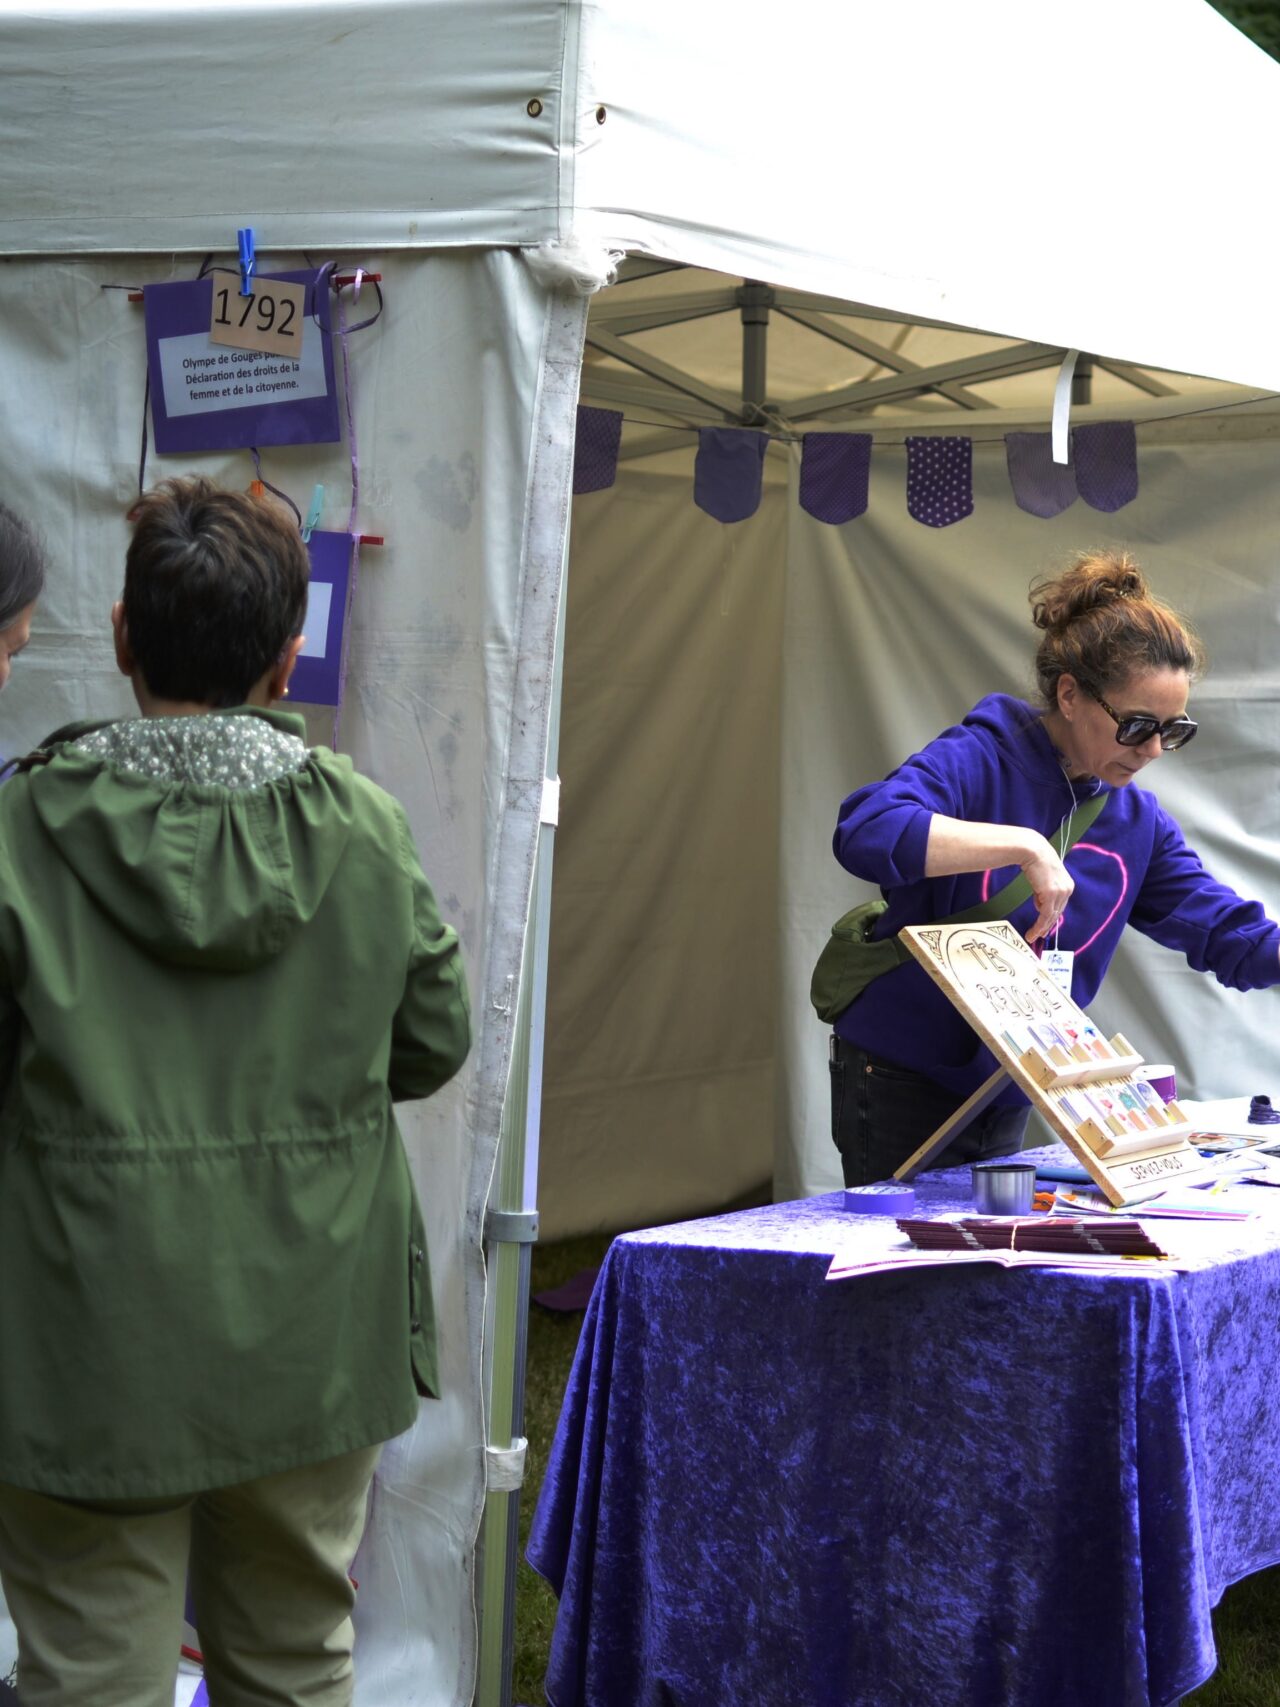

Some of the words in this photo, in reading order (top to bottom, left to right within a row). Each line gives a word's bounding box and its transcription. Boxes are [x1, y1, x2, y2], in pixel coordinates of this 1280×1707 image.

[214, 288, 296, 337] 1792
[182, 358, 216, 370] Olympe
[218, 354, 229, 364] de
[230, 351, 262, 363] Gouges
[185, 370, 235, 384] Déclaration
[236, 369, 252, 379] des
[253, 364, 278, 377] droits
[279, 363, 290, 373] de
[292, 362, 300, 372] la
[189, 389, 220, 400] femme
[222, 387, 230, 397] et
[232, 384, 244, 394] de
[245, 384, 254, 394] la
[255, 380, 299, 393] citoyenne.
